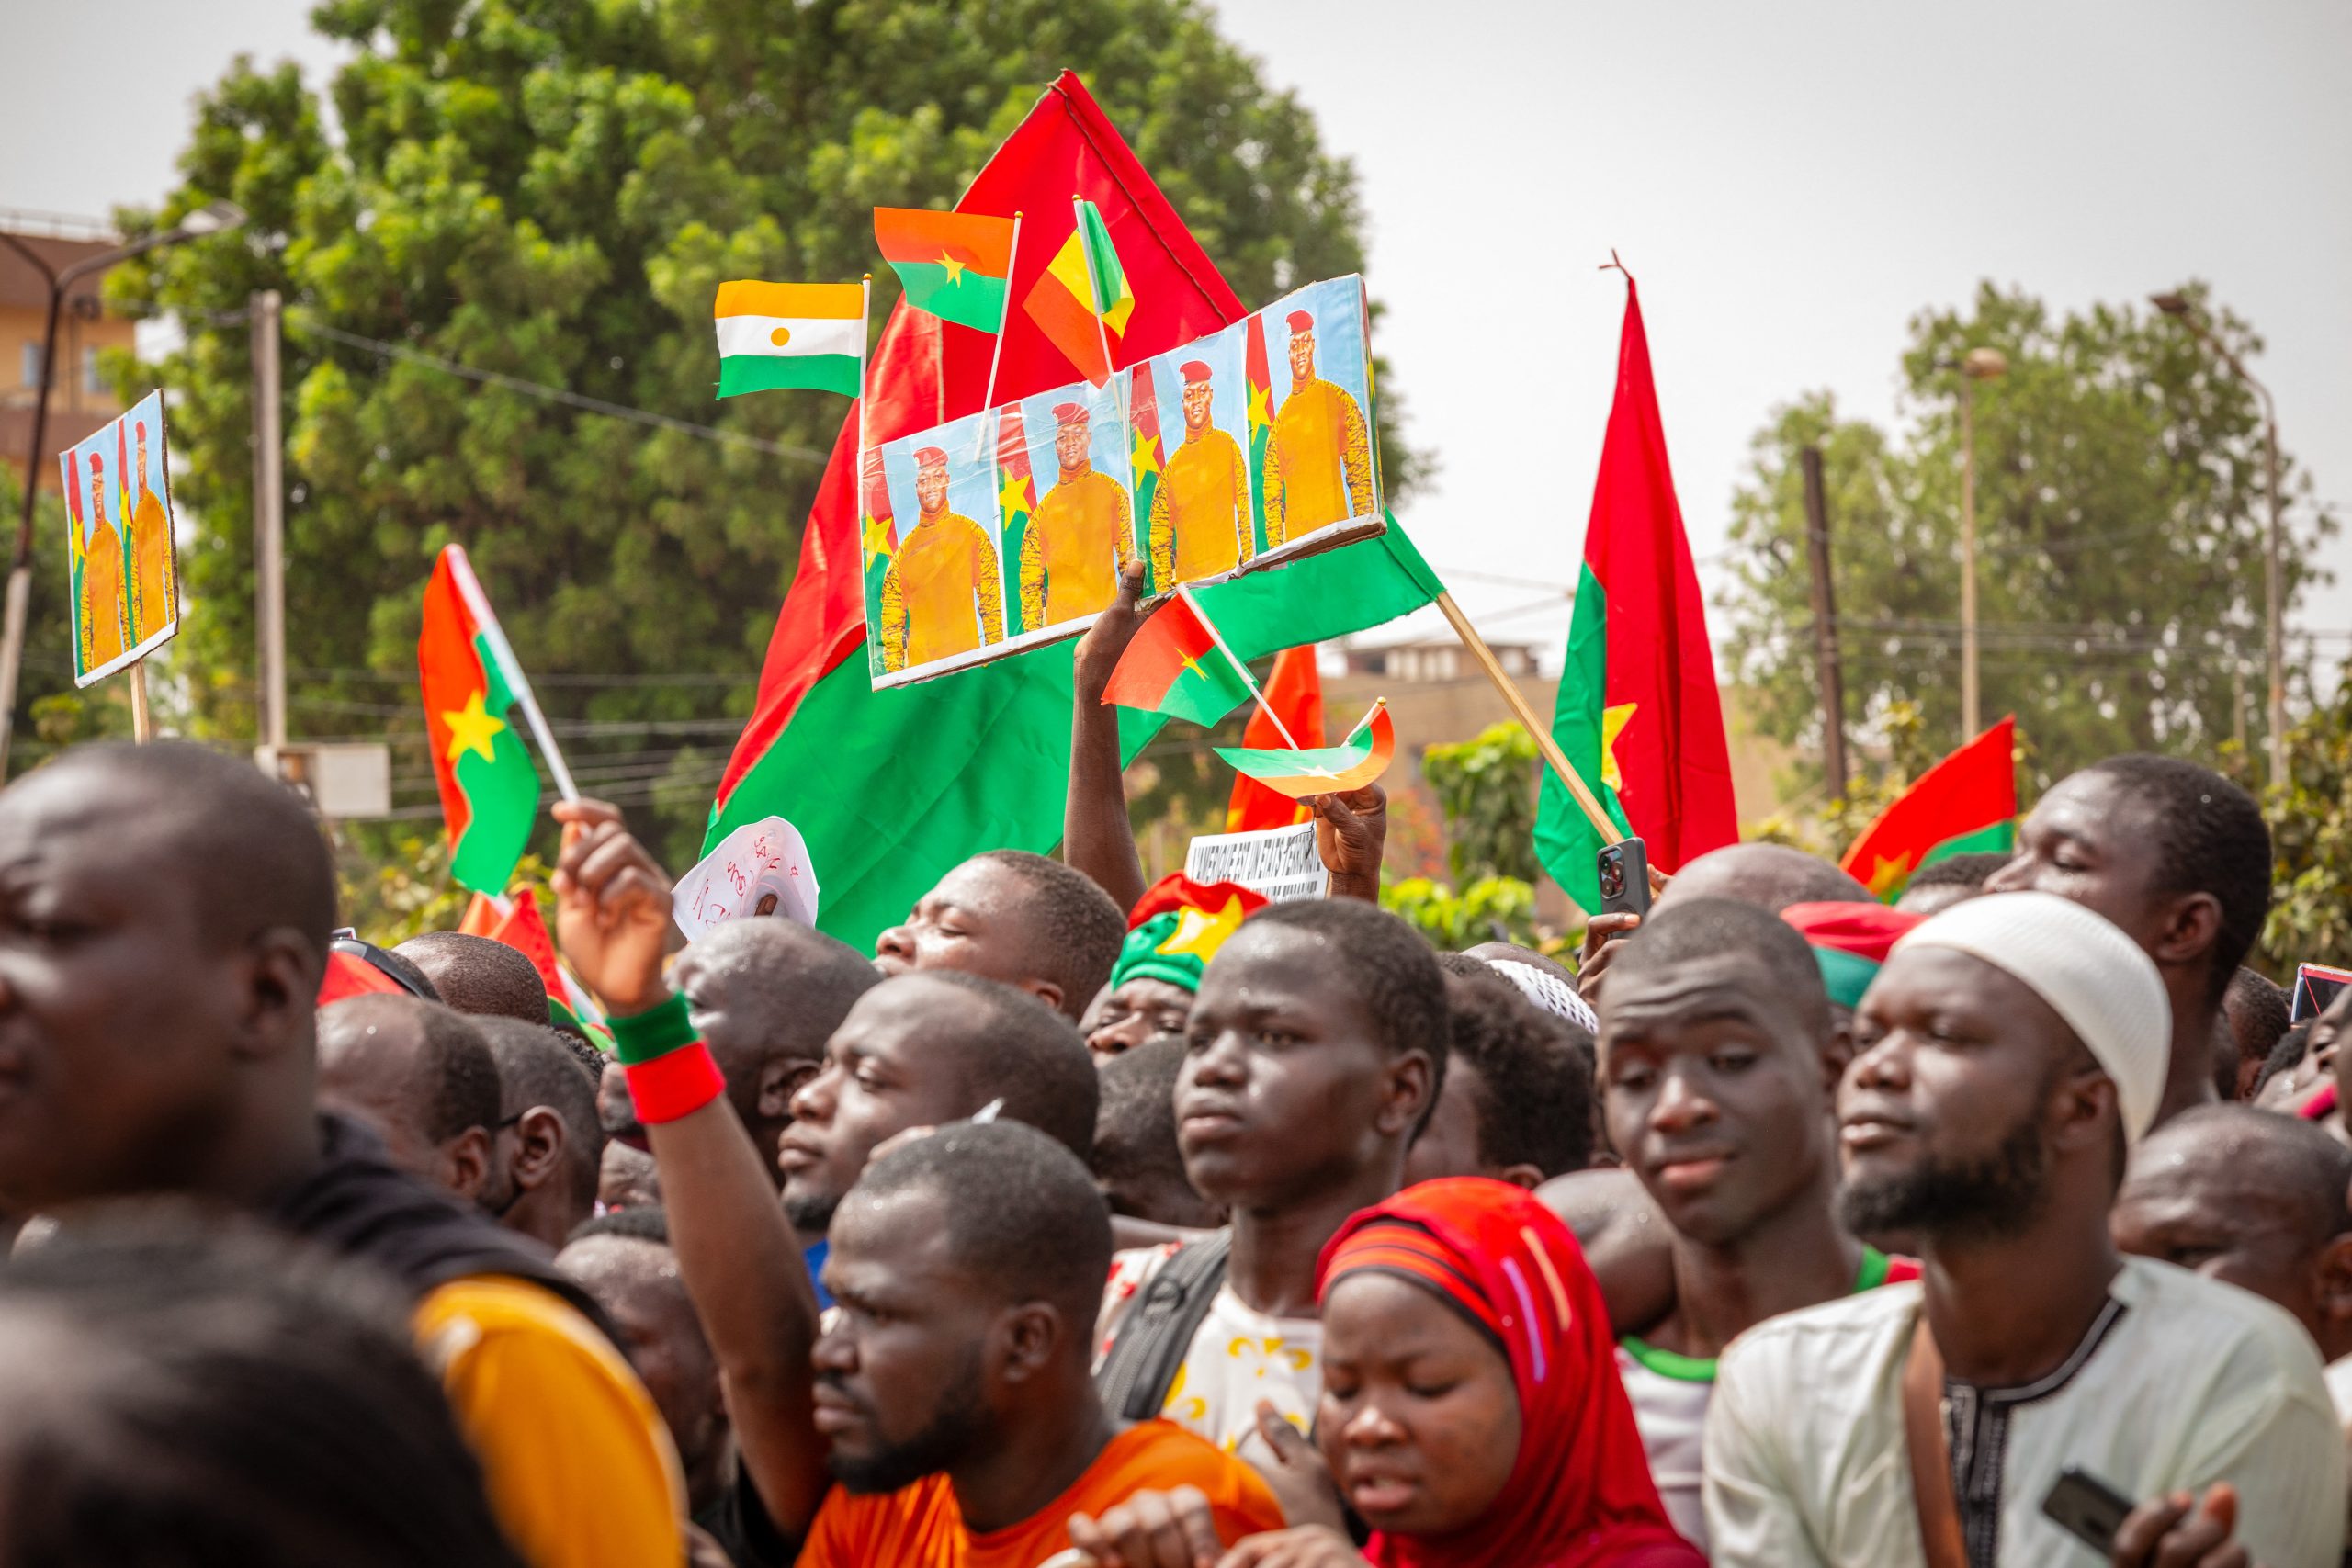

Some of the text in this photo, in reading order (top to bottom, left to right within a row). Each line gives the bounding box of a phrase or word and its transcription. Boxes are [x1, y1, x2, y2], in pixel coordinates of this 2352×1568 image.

[1233, 841, 1251, 882] EST
[1247, 840, 1262, 881] UN
[1258, 836, 1284, 879] ETATS
